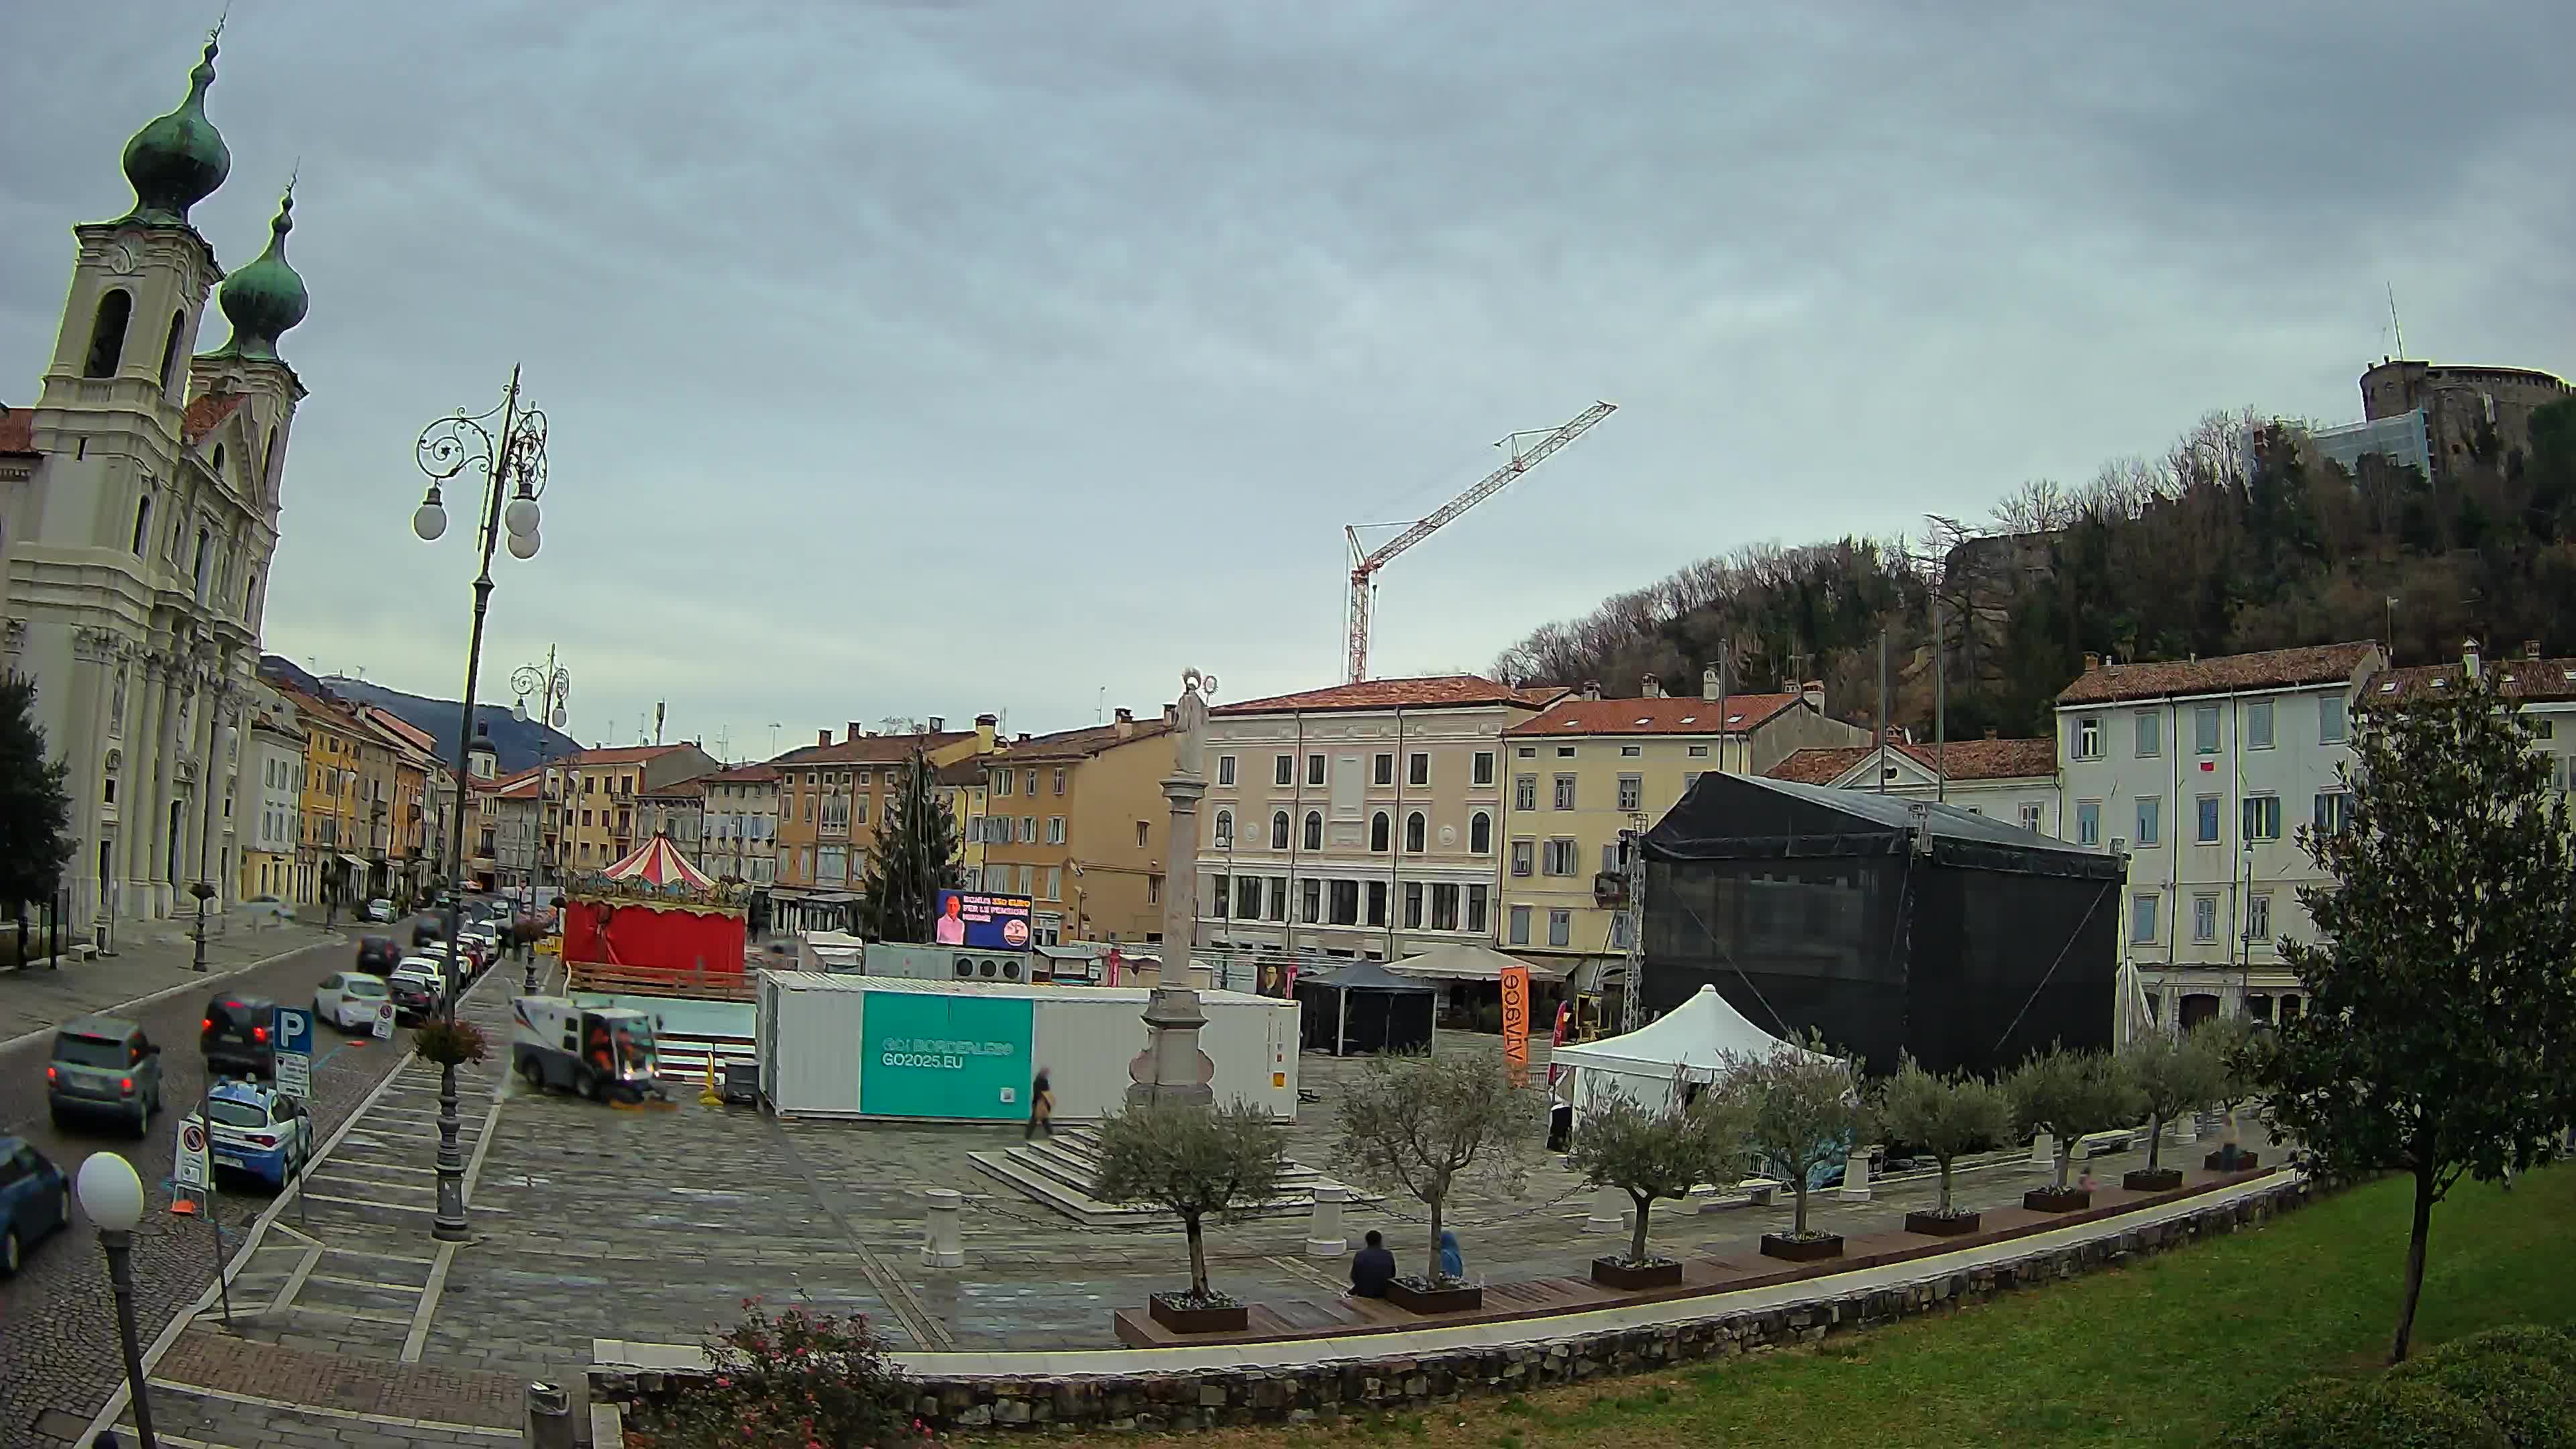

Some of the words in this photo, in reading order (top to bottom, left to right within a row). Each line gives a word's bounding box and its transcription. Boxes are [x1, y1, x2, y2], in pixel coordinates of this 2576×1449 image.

[281, 1012, 305, 1046] P
[913, 1039, 1014, 1055] BORDERLESS
[882, 1053, 963, 1068] GO2025.EU
